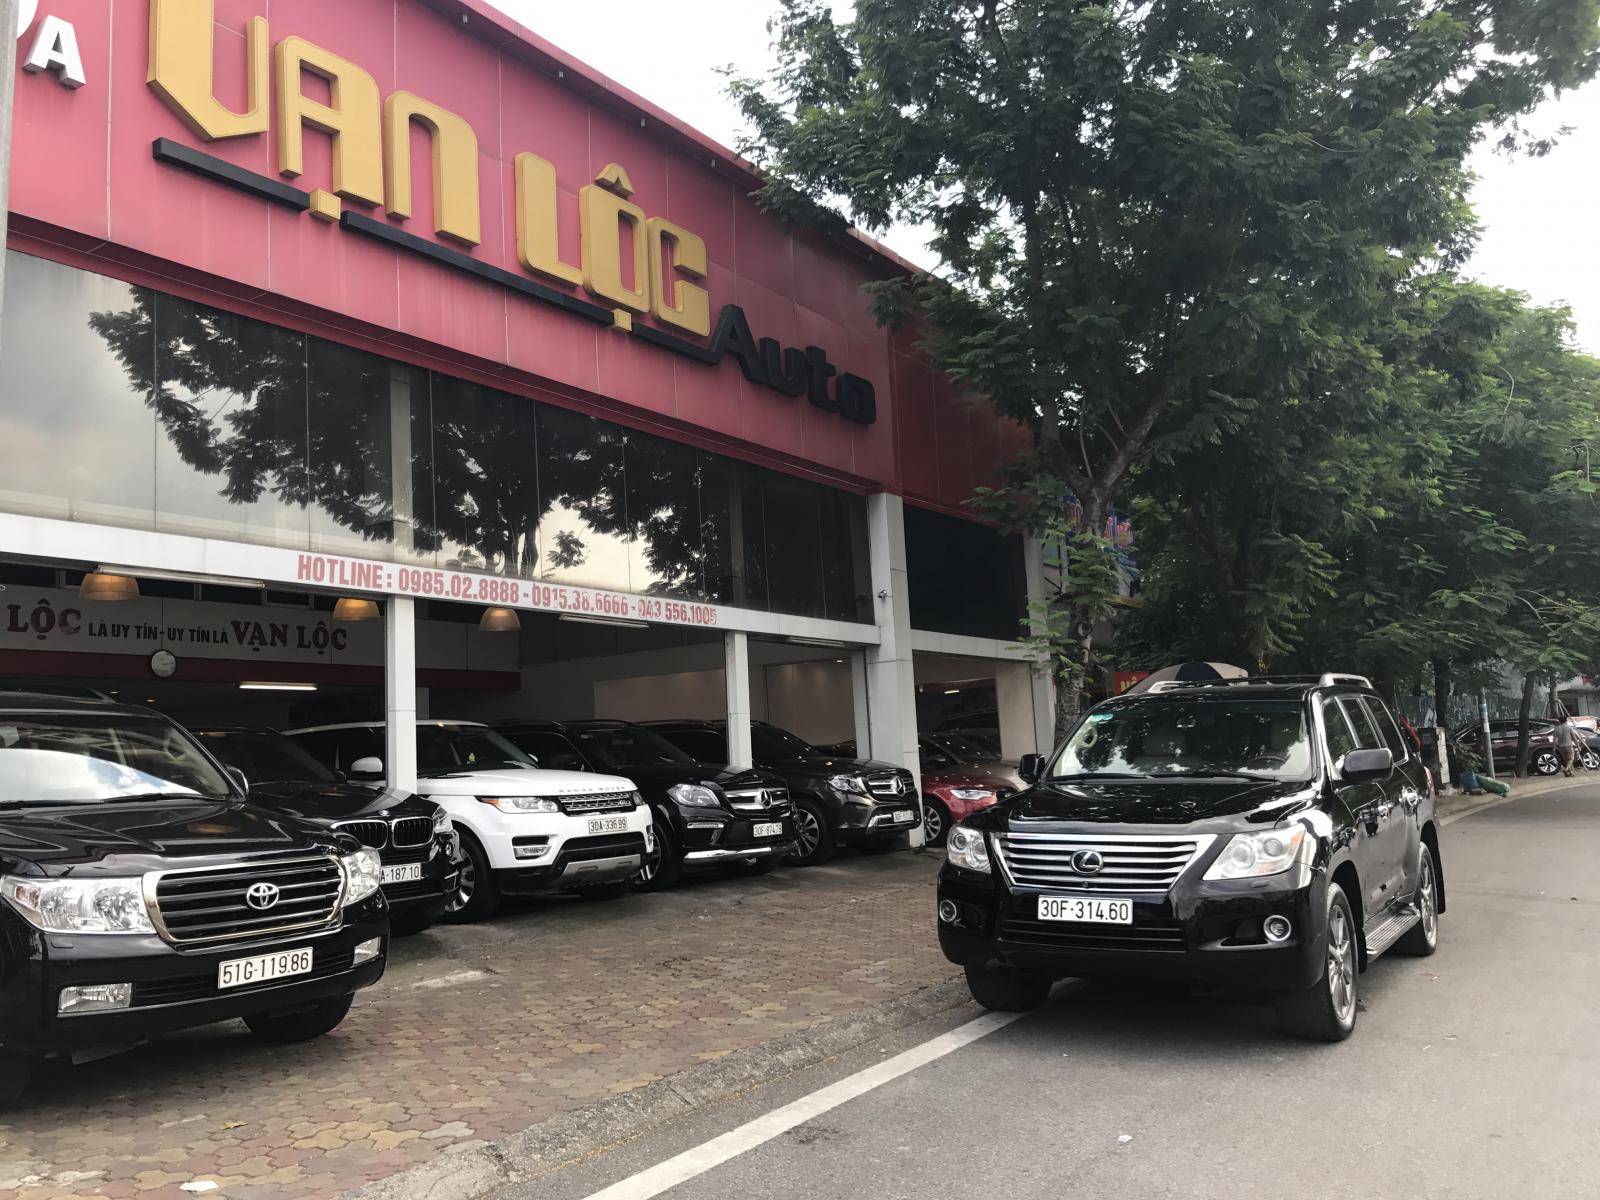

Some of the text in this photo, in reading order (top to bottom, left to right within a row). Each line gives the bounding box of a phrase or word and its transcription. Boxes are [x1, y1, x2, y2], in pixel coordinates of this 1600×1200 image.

[515, 151, 710, 337] LỘC
[708, 304, 877, 425] Auto
[398, 568, 520, 604] 0985.02.8888
[6, 598, 82, 640] LỘC
[111, 623, 131, 639] UY
[134, 622, 158, 640] TÍN
[167, 627, 185, 642] UY
[188, 626, 210, 643] TÍN
[230, 620, 289, 652] VẠN
[296, 620, 348, 655] LỘC
[1040, 899, 1129, 921] 30F-314.60
[223, 951, 309, 984] 51G-119.86
